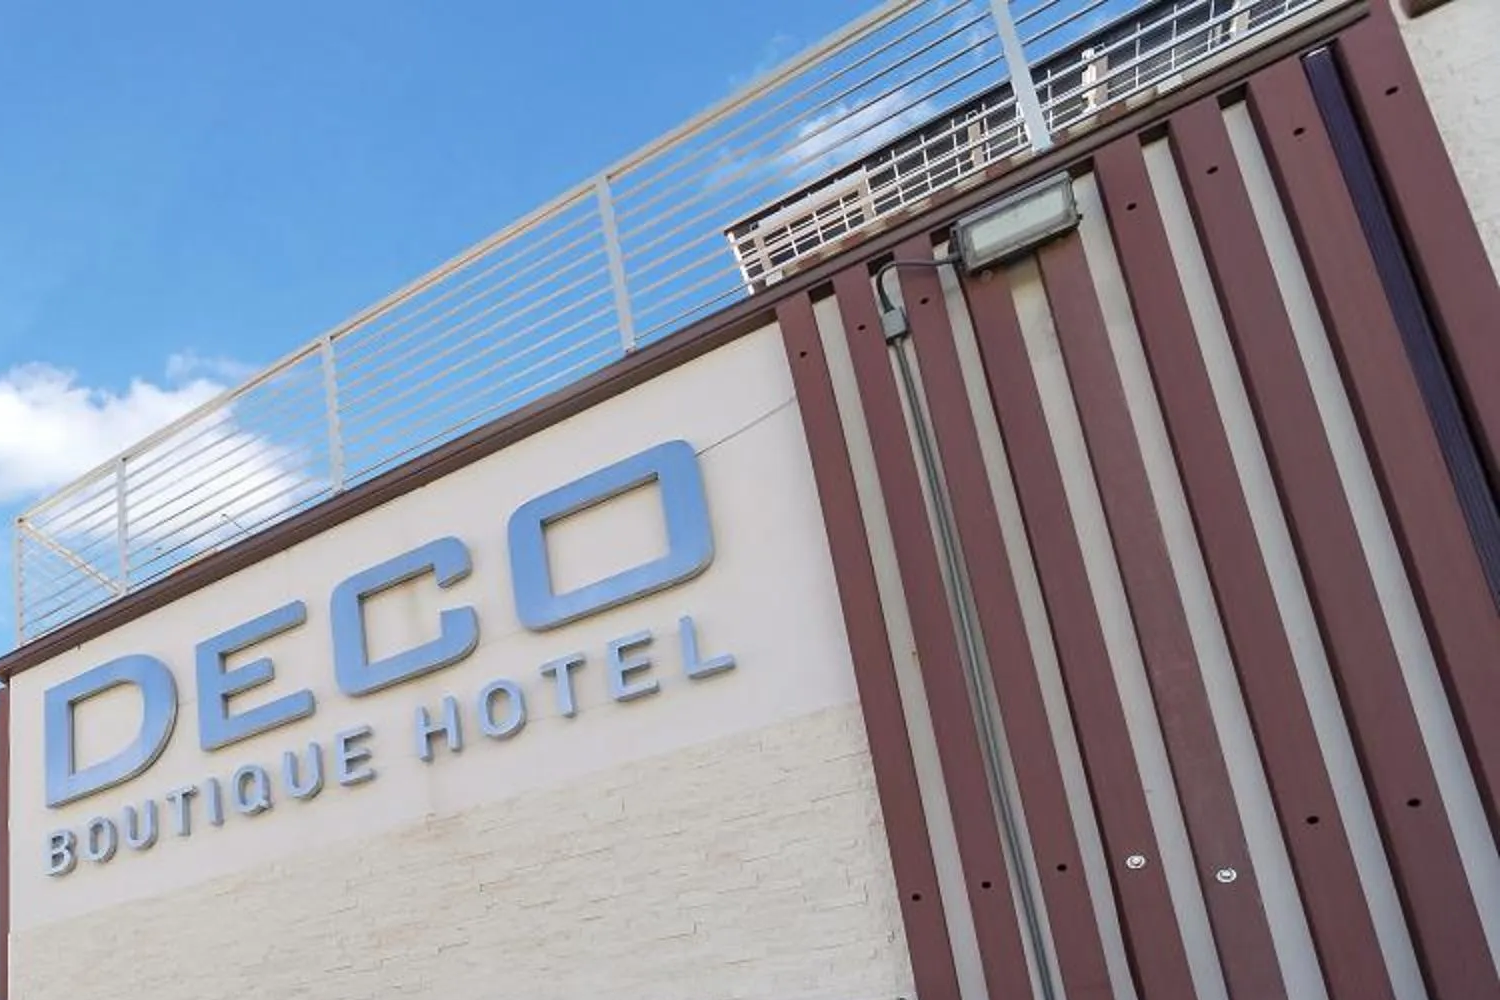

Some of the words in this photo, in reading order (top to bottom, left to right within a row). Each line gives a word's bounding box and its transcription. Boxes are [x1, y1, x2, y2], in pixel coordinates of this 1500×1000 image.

[44, 439, 714, 809] DECO
[46, 725, 378, 877] BOUTIQUE
[416, 616, 737, 762] HOTEL
